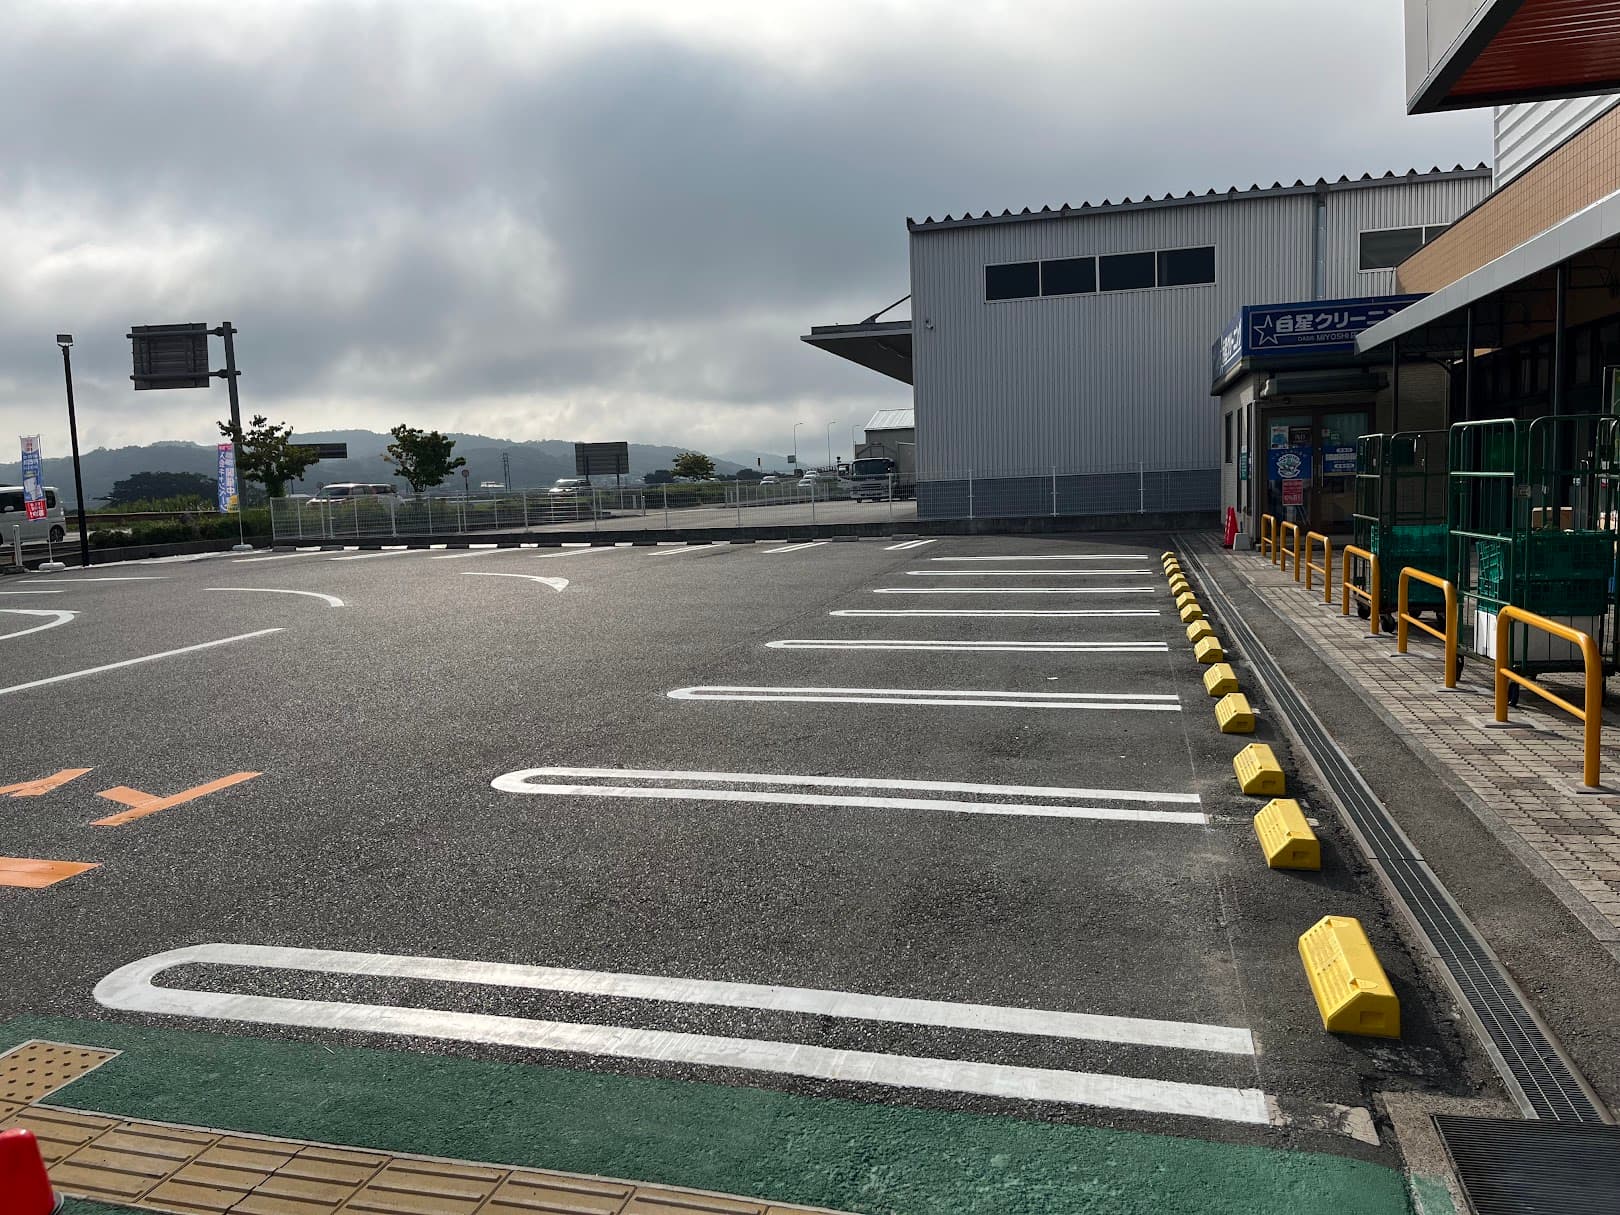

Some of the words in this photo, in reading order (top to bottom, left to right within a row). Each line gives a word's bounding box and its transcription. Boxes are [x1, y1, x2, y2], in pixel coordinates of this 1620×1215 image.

[1276, 309, 1397, 333] 白星クリーニ
